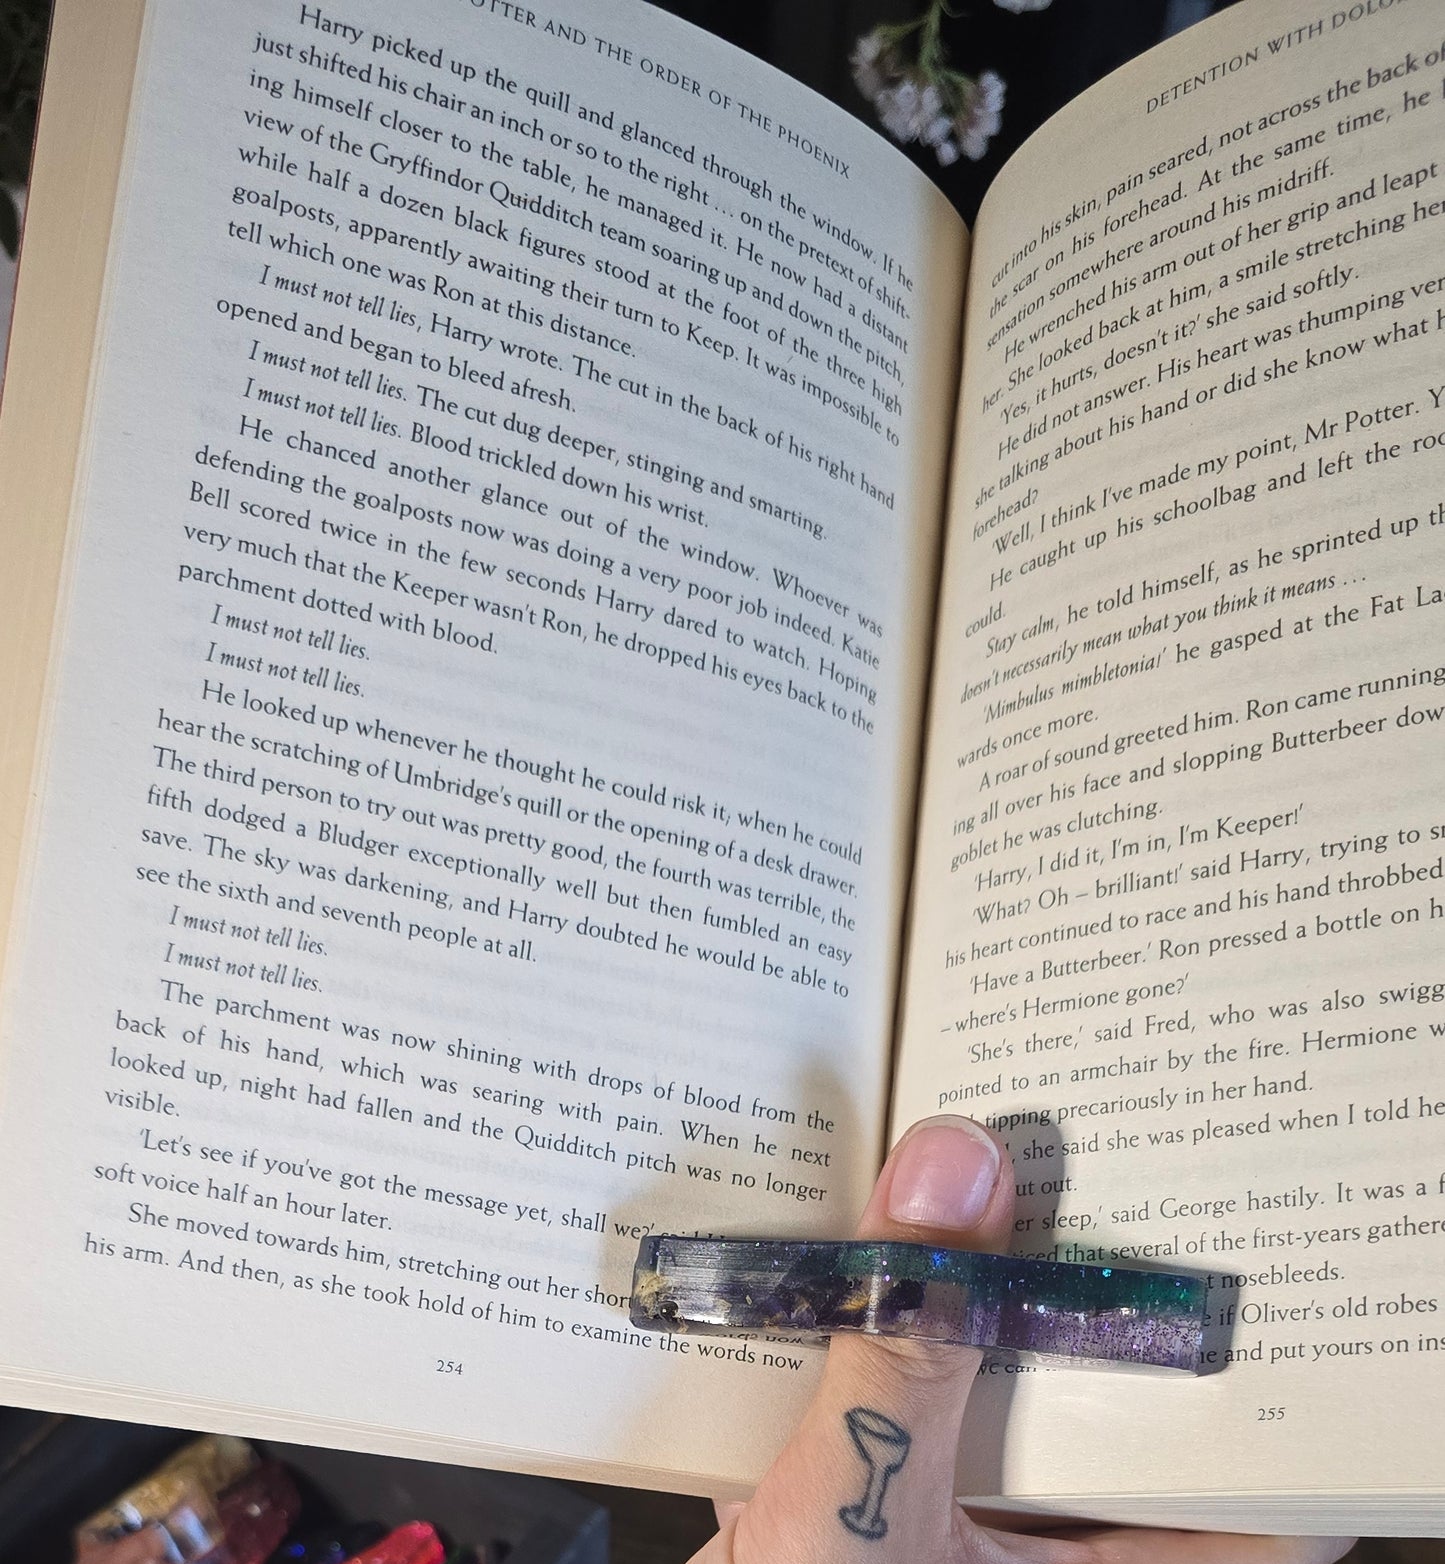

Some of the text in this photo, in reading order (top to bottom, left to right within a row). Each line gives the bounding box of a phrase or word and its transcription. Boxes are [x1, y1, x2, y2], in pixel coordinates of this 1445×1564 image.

[544, 20, 586, 45] AND
[595, 38, 632, 65] THE
[640, 59, 700, 97] ORDER
[709, 90, 731, 109] OF
[738, 103, 771, 132] THE
[778, 125, 849, 179] PHOENIX
[1147, 47, 1258, 114] DETENTION
[1267, 20, 1323, 54] WITH
[300, 4, 913, 292] Harry picked up the quill and glanced through the window. If he
[232, 187, 899, 446] goalposts, apparently awaiting their turn to Keep. It was impossible to
[1005, 163, 1437, 363] He wrenched his arm out of her grip and leapt
[217, 300, 575, 412] opened and began to bleed afresh.
[1001, 265, 1359, 424] 'Yes, it hurts, doesn't it?' she said softly.
[240, 415, 882, 638] He chanced another glance out of the window. Whoever was
[990, 568, 1012, 591] He
[1020, 540, 1075, 575] caught
[1085, 531, 1106, 549] up
[1118, 518, 1143, 537] his
[1154, 484, 1256, 525] schoolbag
[1268, 462, 1306, 491] and
[1318, 451, 1353, 478] left
[1365, 442, 1400, 464] the
[211, 604, 369, 660] I must not tell lies.
[985, 684, 1053, 723] 'Mimbulus
[1176, 643, 1199, 663] he
[1210, 618, 1283, 658] gasped
[1294, 617, 1312, 635] at
[1325, 605, 1359, 627] the
[1371, 595, 1404, 617] Fat
[148, 784, 852, 966] fifth dodged a Bludger exceptionally well but then fumbled an easy
[975, 803, 1303, 891] 'Harry, I did it, I'm in, I'm Keeper!'
[946, 857, 1443, 969] his heart continued to race and his hand throbbed
[161, 979, 834, 1133] The parchment was now shining with drops of blood from the
[939, 1074, 1001, 1109] pointed
[1012, 1077, 1029, 1090] to
[1039, 1073, 1059, 1086] an
[1071, 1056, 1158, 1082] armchair
[1168, 1049, 1193, 1072] by
[1204, 1043, 1237, 1064] the
[1249, 1038, 1289, 1059] fire.
[1303, 1027, 1417, 1052] Hermione
[1042, 1206, 1102, 1230] sleep,'
[1111, 1200, 1150, 1223] said
[1160, 1198, 1236, 1218] George
[1247, 1186, 1324, 1211] hastily.
[1337, 1182, 1353, 1203] It
[1363, 1185, 1404, 1200] was
[1416, 1183, 1427, 1196] a
[437, 1360, 462, 1375] 254
[1258, 1407, 1285, 1421] 255
